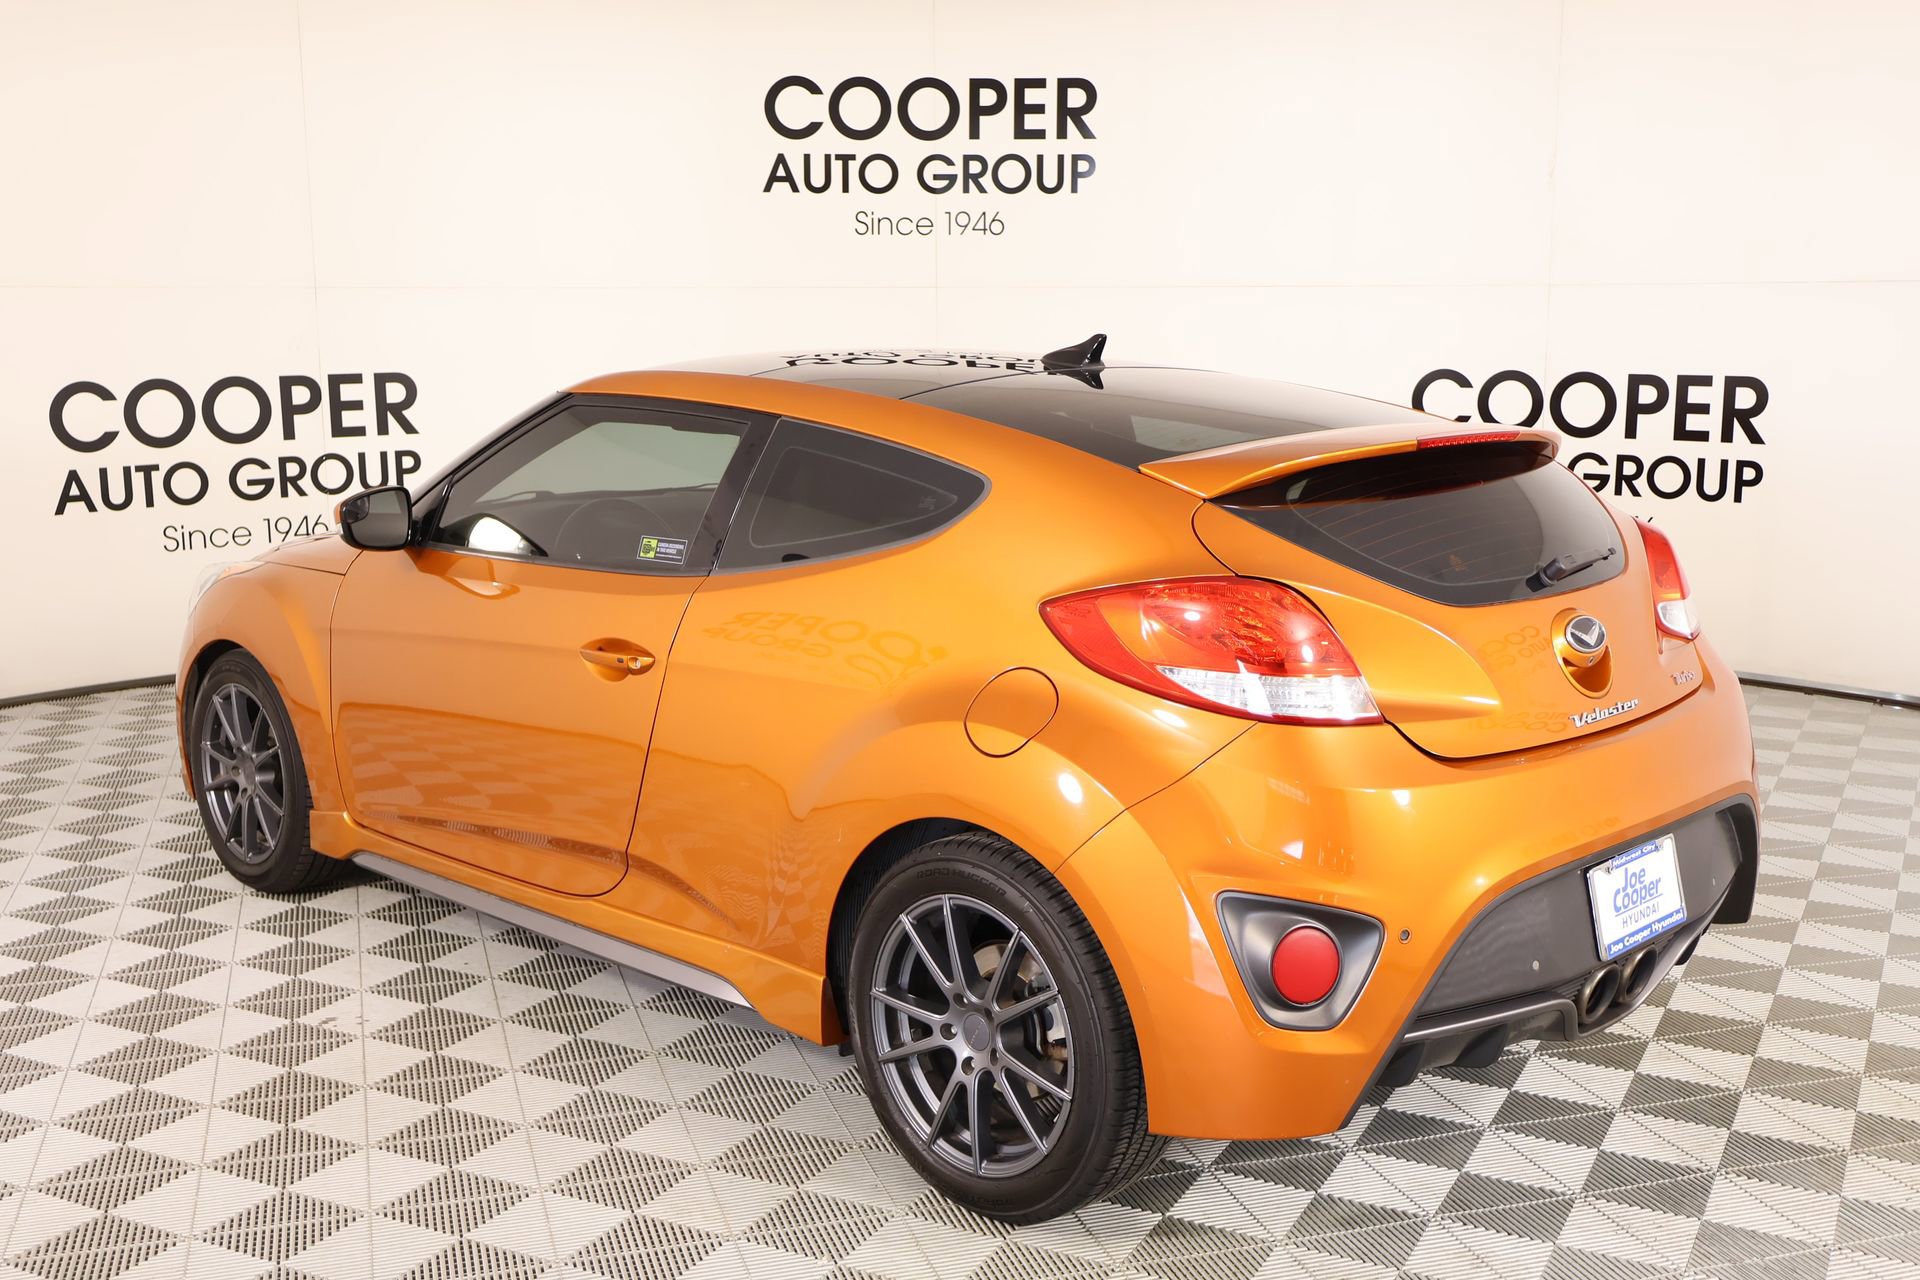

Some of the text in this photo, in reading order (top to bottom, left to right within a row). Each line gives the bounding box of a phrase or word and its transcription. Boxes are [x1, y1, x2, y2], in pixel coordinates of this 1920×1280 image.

[764, 75, 1098, 141] COOPER
[763, 153, 1097, 194] AUTO GROUP
[854, 210, 1005, 236] Since 1946
[49, 372, 420, 453] COOPER
[1411, 368, 1769, 445] COOPER
[54, 450, 422, 515] AUTO GROUP
[1567, 452, 1764, 504] GROUP
[162, 524, 253, 552] Since
[1569, 698, 1639, 729] Veloster
[1613, 877, 1662, 914] Cooper
[1621, 867, 1646, 893] Joe
[1610, 910, 1683, 955] Joe Cooper Hyundai
[1622, 901, 1660, 929] HYUNDAI
